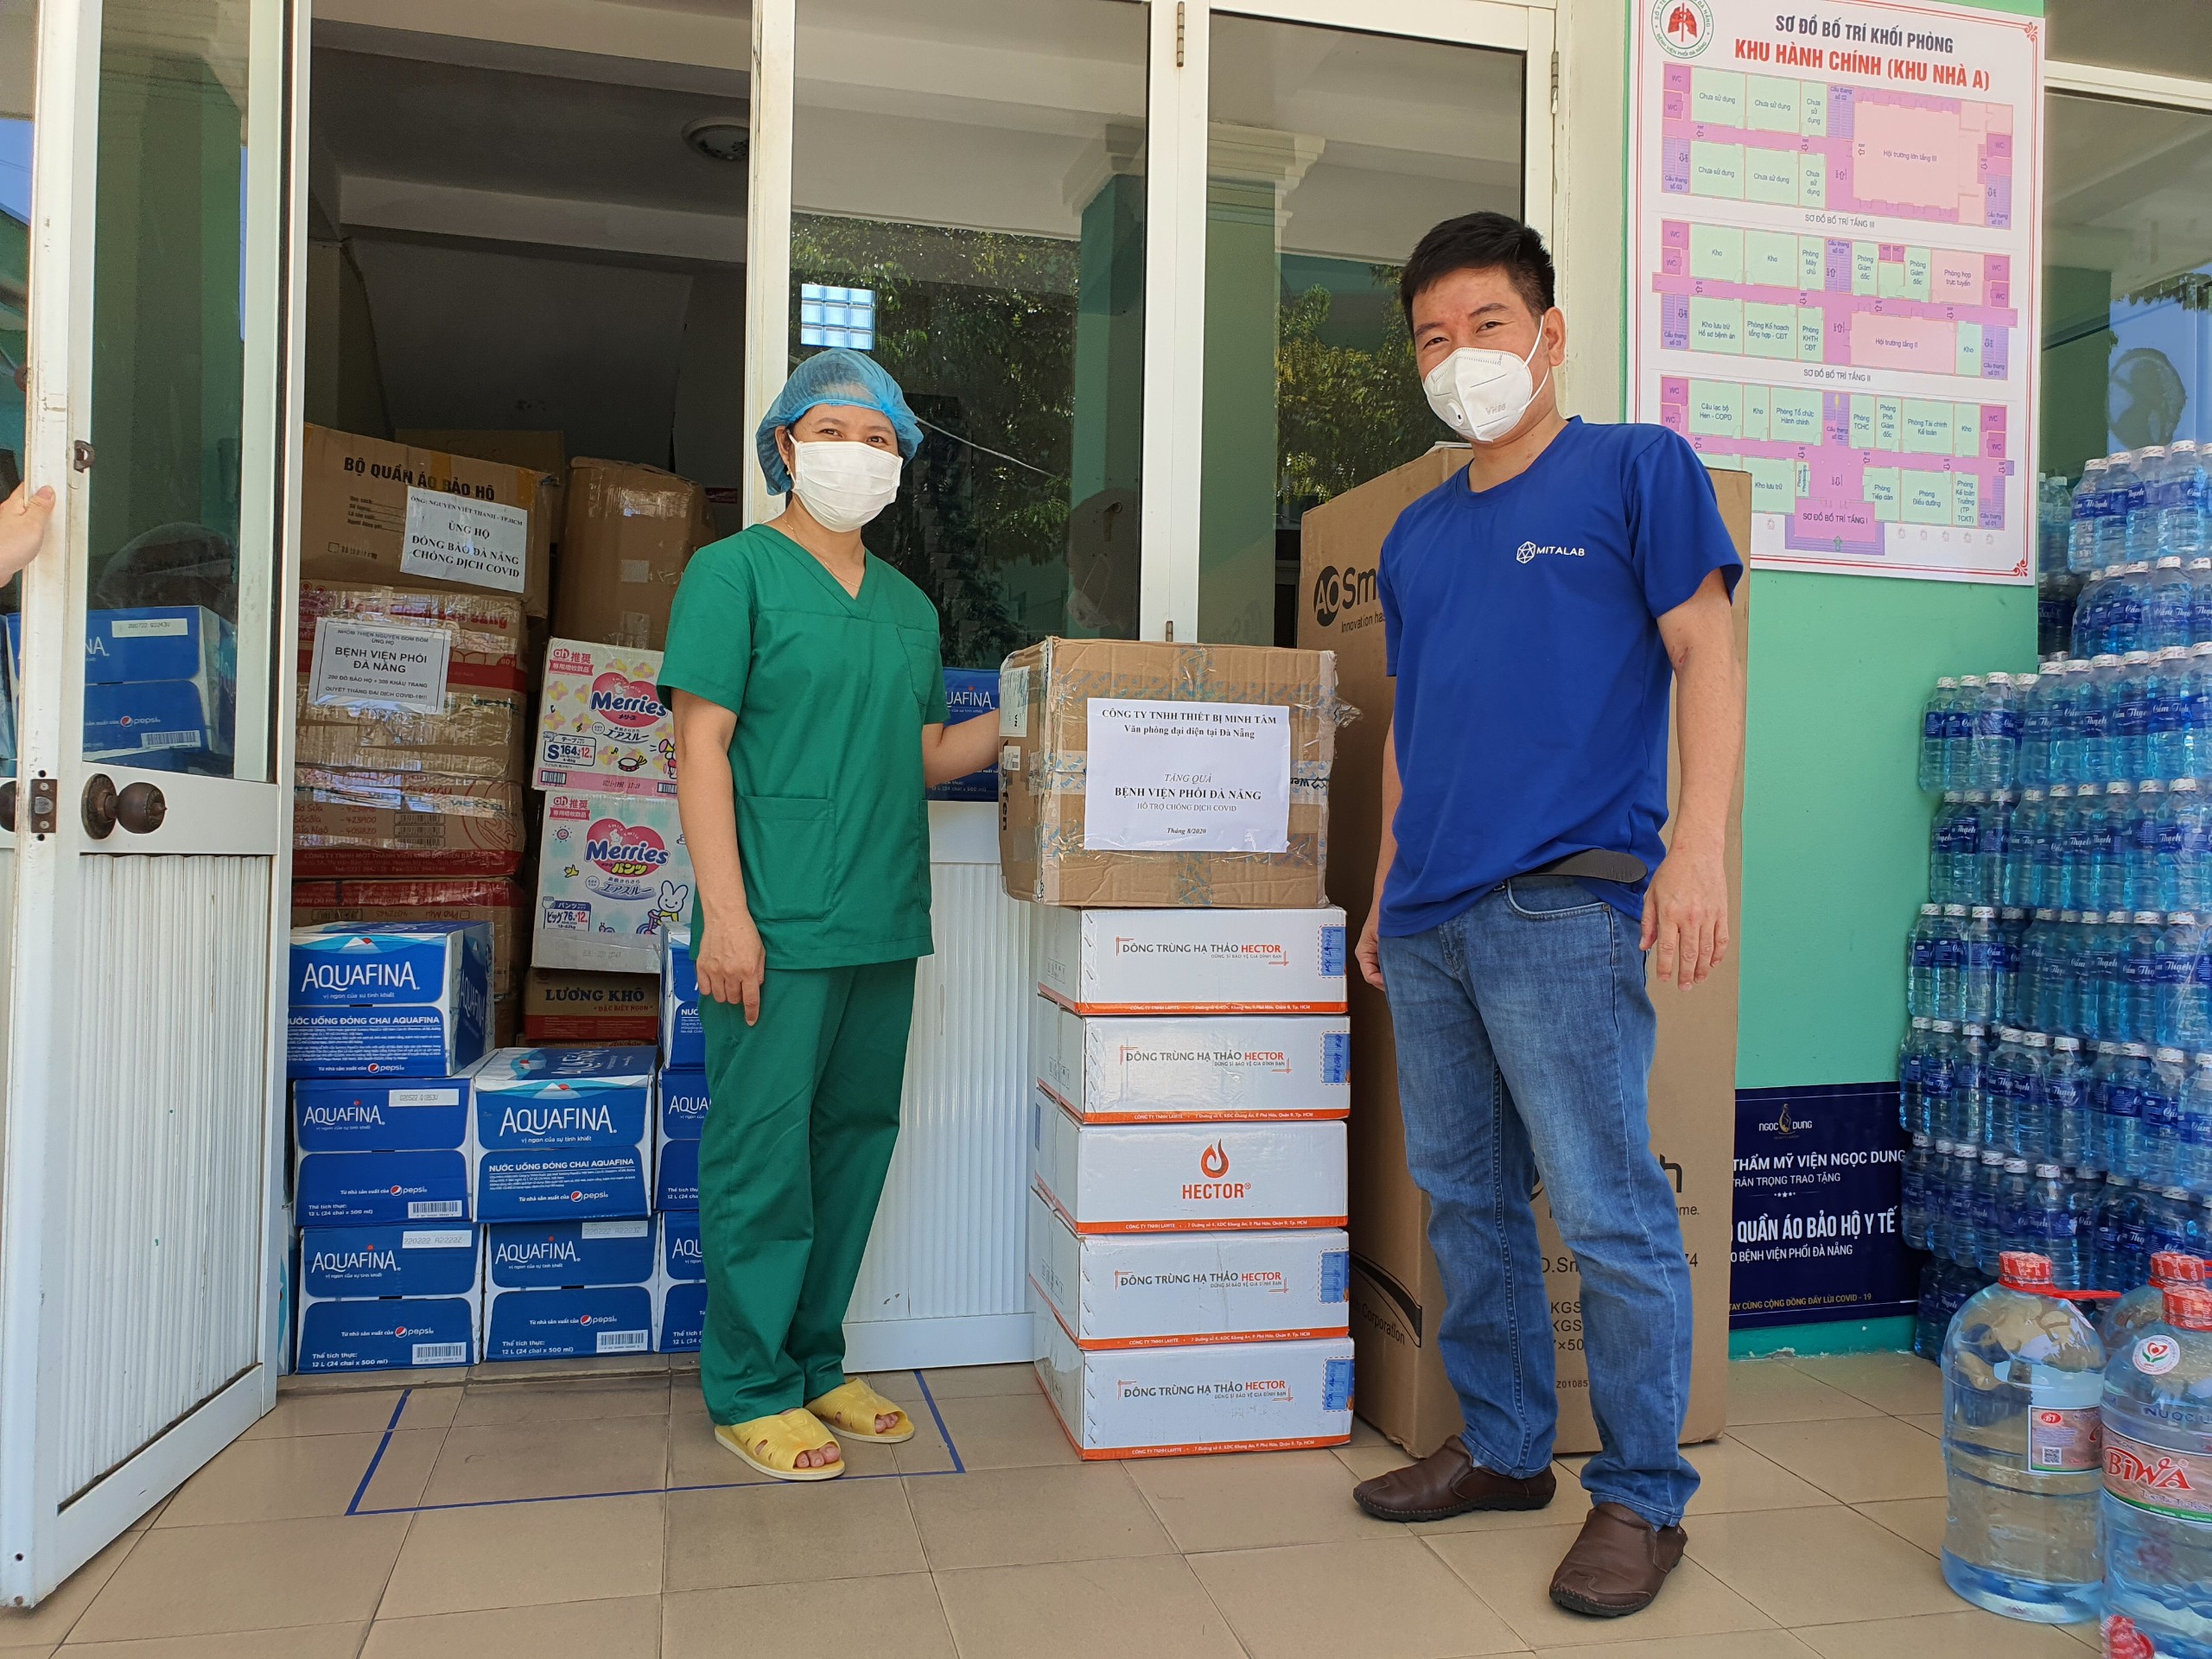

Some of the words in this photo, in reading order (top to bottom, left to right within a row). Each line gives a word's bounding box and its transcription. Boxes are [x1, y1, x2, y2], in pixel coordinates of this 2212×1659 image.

[1776, 15, 1796, 33] SƠ
[1822, 17, 1841, 38] BỐ
[1846, 22, 1866, 41] TRÍ
[1871, 25, 1903, 47] KHỐI
[1908, 31, 1954, 54] PHÒNG
[1735, 39, 1770, 61] KHU
[1776, 41, 1823, 68] HÀNH
[1829, 50, 1881, 75] CHÍNH
[1888, 59, 1928, 84] (KHU
[1933, 63, 1967, 86] NHÀ
[1973, 70, 1990, 91] A)
[344, 457, 365, 476] BỘ
[1536, 545, 1585, 556] MITALAB
[456, 557, 483, 570] DỊCH
[486, 564, 519, 577] COVID
[1341, 613, 1373, 632] Innovation
[335, 646, 367, 658] BỆNH
[353, 660, 370, 669] ĐÀ
[591, 691, 667, 716] Merries
[945, 691, 995, 709] UAFINA
[1102, 708, 1131, 718] CÔNG
[1149, 711, 1178, 720] TNHH
[1212, 715, 1223, 724] BỊ
[1254, 714, 1276, 724] TÂM
[1144, 725, 1169, 736] phòng
[1171, 727, 1184, 736] đại
[1186, 728, 1204, 736] diện
[1115, 786, 1145, 798] BỆNH
[1148, 788, 1175, 799] VIỆN
[585, 840, 670, 864] Merries
[1156, 943, 1191, 953] TRÙNG
[1194, 944, 1207, 954] HẠ
[1241, 944, 1281, 953] HECTOR
[302, 961, 420, 993] AQUAFINA
[545, 988, 605, 1001] LƯƠNG
[608, 987, 645, 1002] KHÔ
[1160, 1050, 1195, 1061] TRÙNG
[1197, 1052, 1211, 1063] HẠ
[303, 1104, 385, 1126] AQUAFINA
[499, 1104, 617, 1137] AQUAFINA
[489, 1163, 514, 1172] NƯỚC
[591, 1159, 634, 1167] AQUAFINA
[1732, 1154, 1770, 1171] THẨM
[1773, 1153, 1794, 1169] MỸ
[1797, 1152, 1827, 1169] VIỆN
[1831, 1152, 1867, 1167] NGỌC
[1871, 1150, 1906, 1163] DUNG
[1757, 1176, 1788, 1187] TRỌNG
[1790, 1174, 1814, 1184] TRAO
[1816, 1172, 1840, 1184] TẶNG
[582, 1192, 608, 1200] pepsi
[1738, 1213, 1778, 1243] QUẦN
[1783, 1214, 1802, 1239] ÁO
[1807, 1210, 1836, 1238] BẢO
[1841, 1210, 1860, 1239] HỘ
[1864, 1213, 1874, 1234] Y
[1878, 1205, 1897, 1233] TẾ
[311, 1250, 401, 1274] AQUAFINA
[495, 1241, 581, 1264] AQUAFINA
[1739, 1249, 1764, 1263] BỆNH
[1766, 1247, 1787, 1261] VIỆN
[1813, 1244, 1825, 1257] ĐÀ
[1155, 1273, 1190, 1284] TRÙNG
[1193, 1274, 1207, 1283] HẠ
[1210, 1270, 1238, 1281] THẢO
[1241, 1272, 1281, 1281] HECTOR
[1363, 1303, 1404, 1345] Corporation
[1159, 1383, 1194, 1395] TRÙNG
[1197, 1384, 1211, 1395] HẠ
[1214, 1382, 1243, 1393] THẢO
[1245, 1381, 1285, 1390] HECTOR
